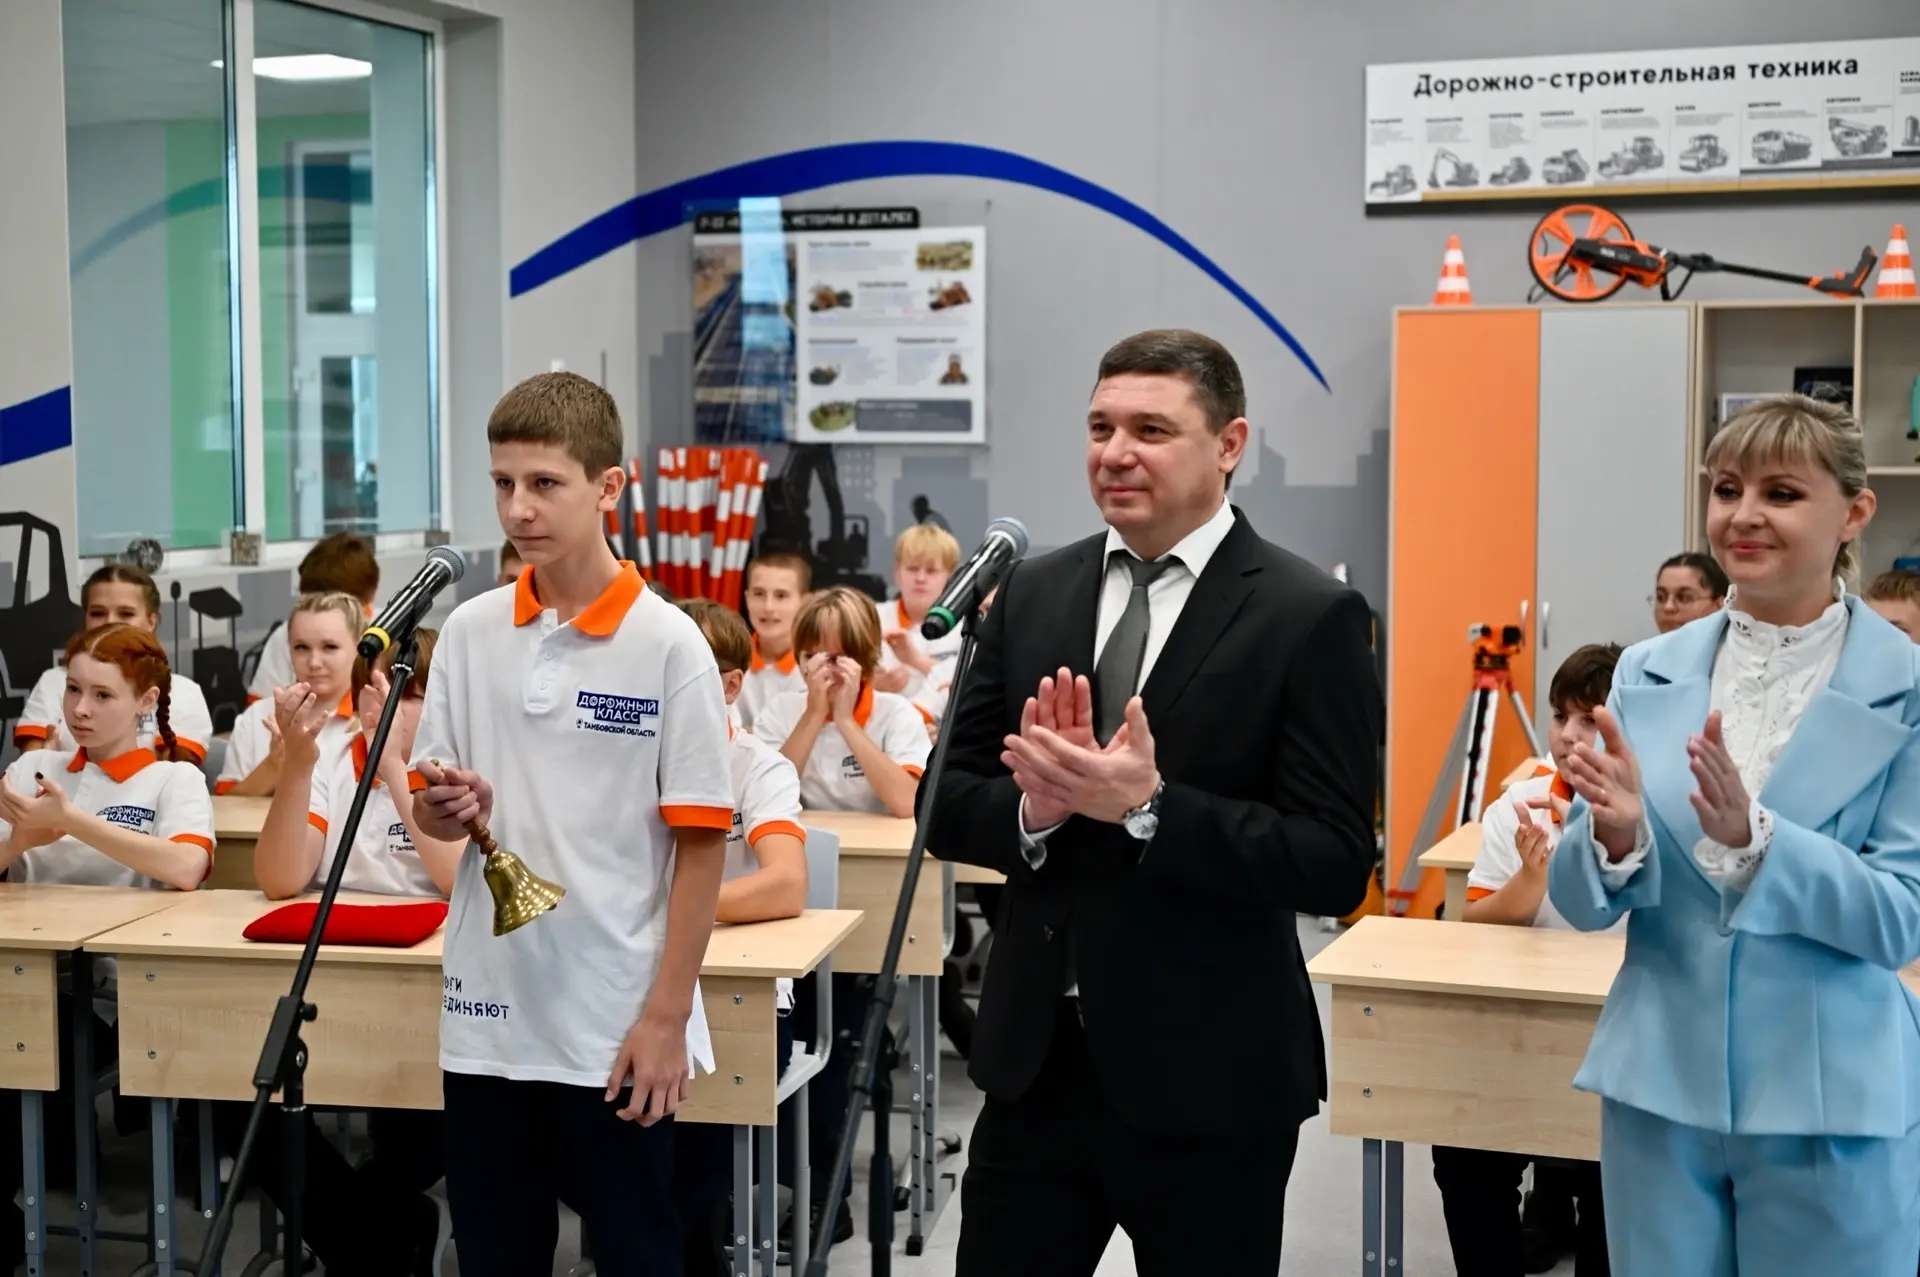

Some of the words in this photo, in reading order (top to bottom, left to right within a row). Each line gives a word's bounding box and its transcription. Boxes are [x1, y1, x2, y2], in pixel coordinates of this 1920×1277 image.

[1414, 64, 1736, 99] Дорожно-строительная
[1748, 58, 1859, 79] техника
[578, 694, 657, 714] ДОРОЖНЫЙ
[595, 707, 639, 722] КЛАСС
[584, 721, 626, 735] ТАМБОВСКОЙ
[626, 727, 656, 738] ОБЛАСТИ
[108, 813, 141, 825] КЛАСС
[444, 975, 462, 993] ОГИ
